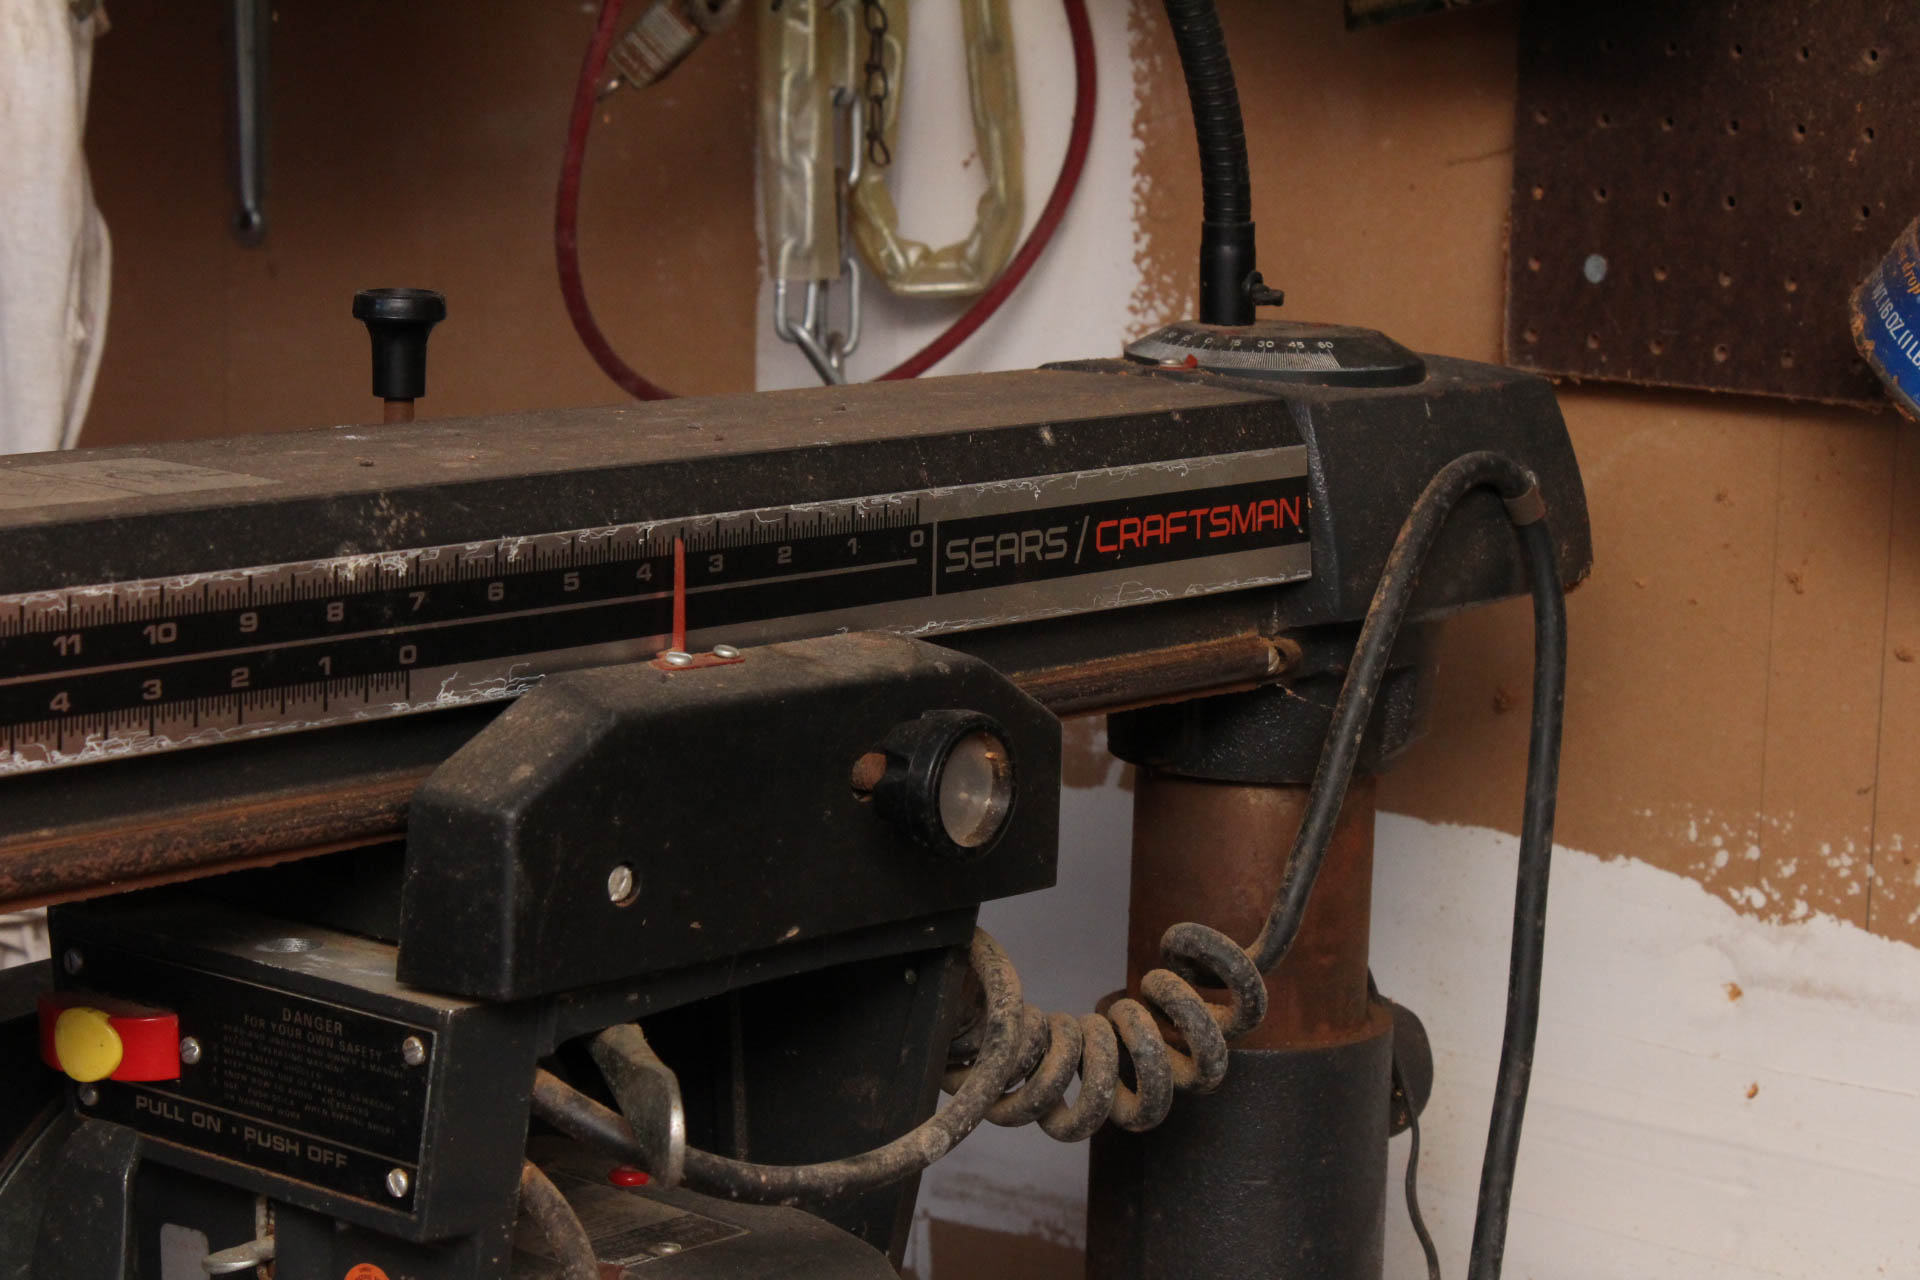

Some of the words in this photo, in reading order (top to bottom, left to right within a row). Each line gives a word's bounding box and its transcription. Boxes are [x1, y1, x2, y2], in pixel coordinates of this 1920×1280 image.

[1257, 340, 1275, 348] 30
[1288, 341, 1305, 349] 45
[1096, 496, 1300, 553] CRAFTSMAN
[53, 634, 82, 656] 11
[143, 622, 177, 645] 10
[239, 612, 258, 633] 9
[326, 602, 345, 622] 8
[408, 591, 427, 611] 7
[488, 582, 504, 600] 6
[563, 572, 580, 592] 5
[636, 563, 653, 581] 4
[708, 555, 724, 572] 3
[777, 546, 792, 564] 2
[847, 537, 858, 554] 1
[910, 530, 924, 547] 0
[50, 691, 71, 712] 4
[143, 679, 162, 700] 3
[231, 667, 250, 688] 2
[318, 656, 333, 675] 1
[400, 645, 417, 665] 0
[271, 1020, 302, 1040] YOUR
[307, 1030, 334, 1049] OWN
[282, 1007, 343, 1036] DANGER
[135, 1095, 184, 1122] PULL
[192, 1111, 221, 1133] ON
[244, 1126, 299, 1156] PUSH
[307, 1145, 348, 1168] OFF
